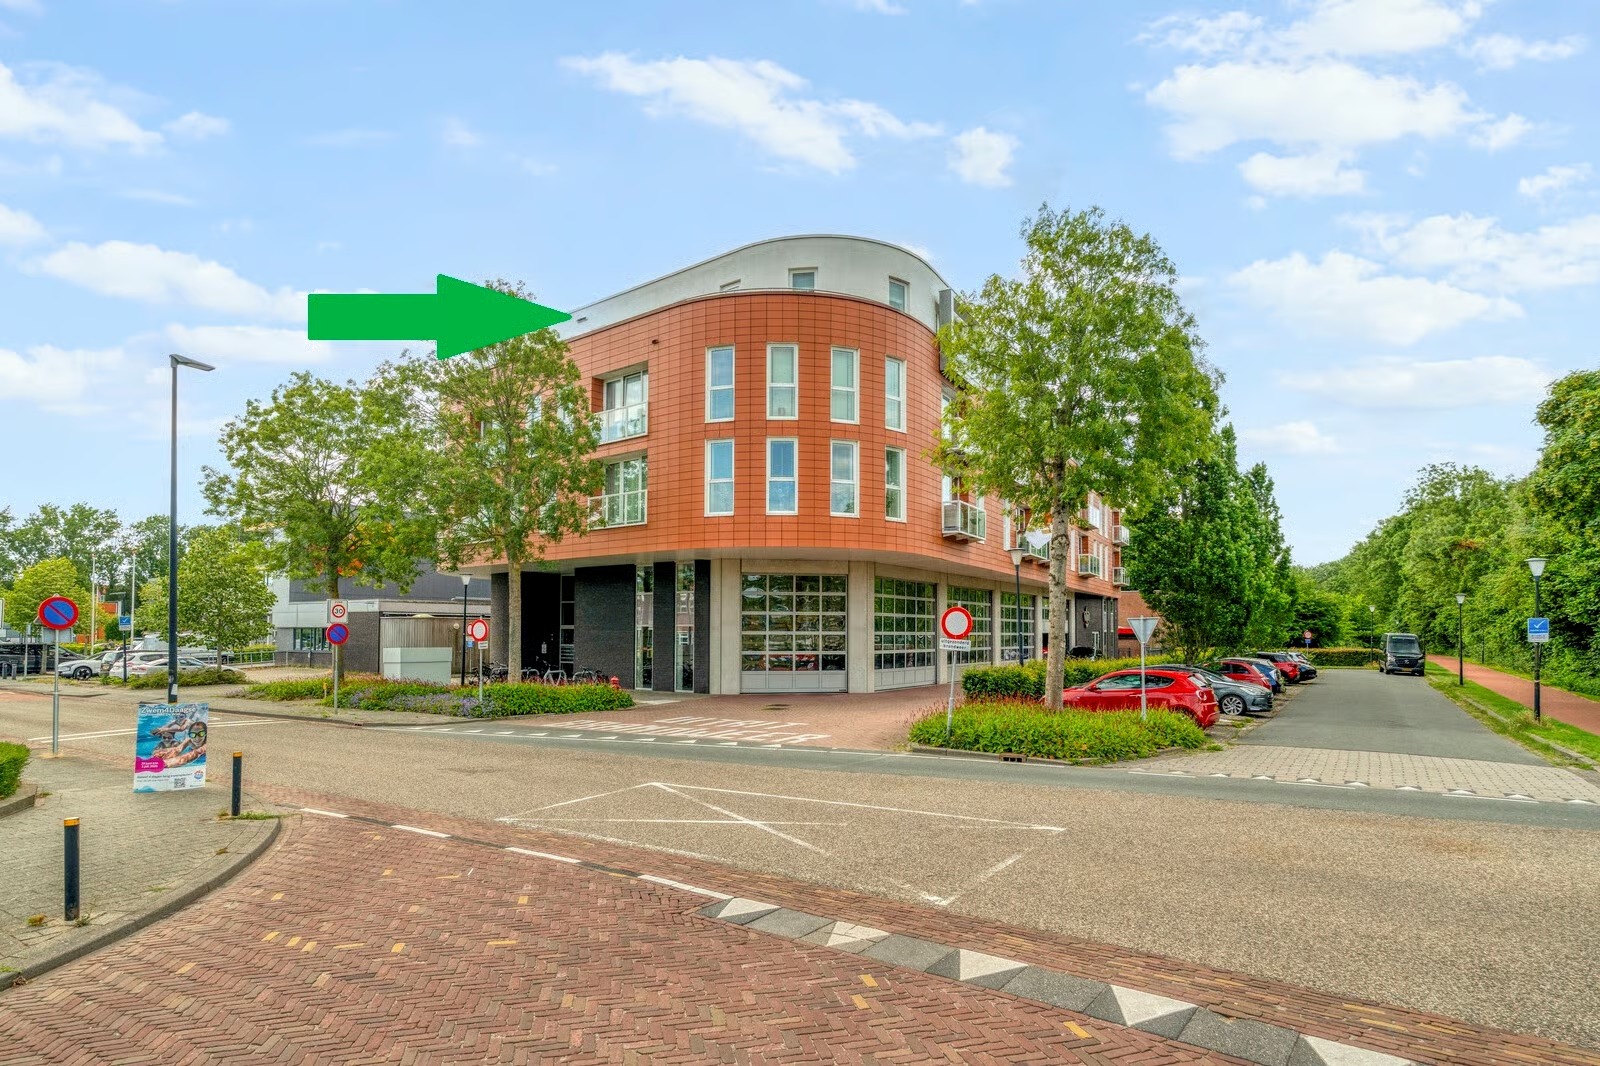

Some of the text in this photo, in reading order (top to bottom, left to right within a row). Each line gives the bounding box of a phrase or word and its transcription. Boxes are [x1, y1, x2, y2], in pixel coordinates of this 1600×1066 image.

[141, 706, 196, 714] Zwem4Daagse
[653, 716, 809, 730] UITRIT
[541, 719, 832, 744] BRANDWEER
